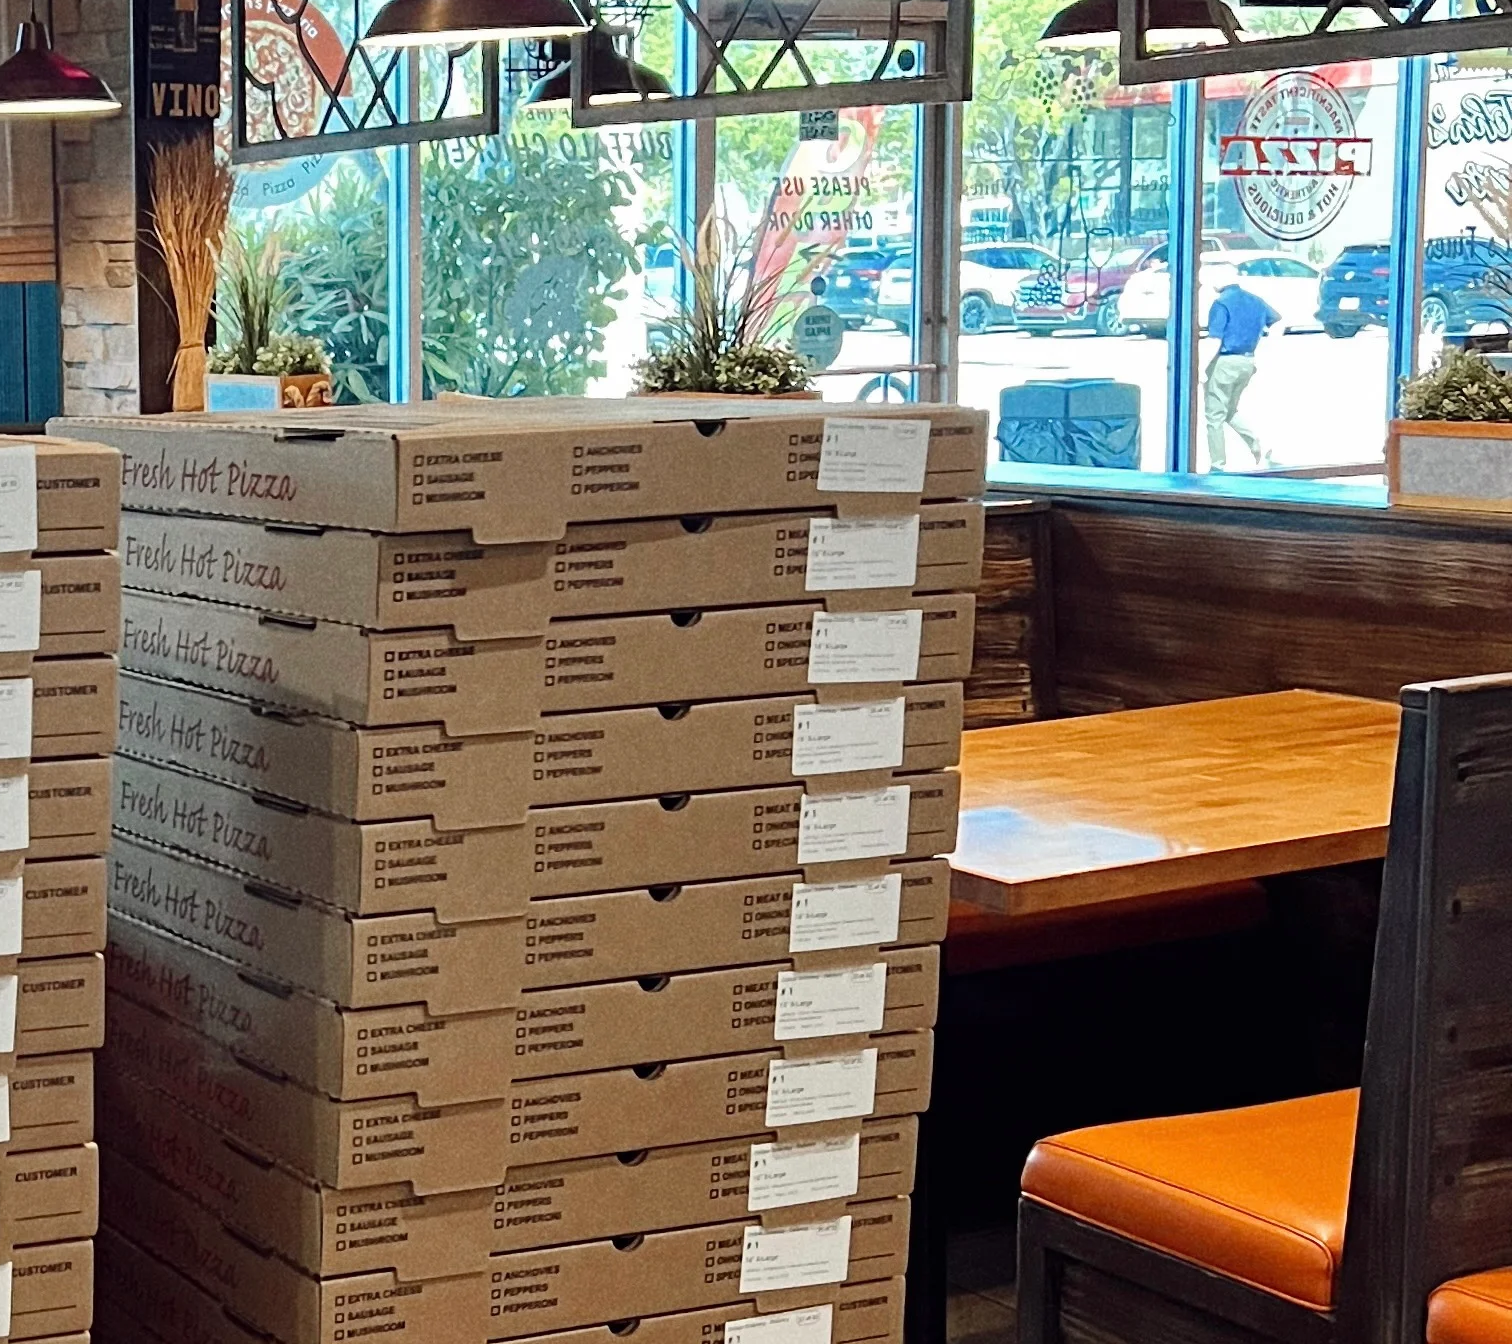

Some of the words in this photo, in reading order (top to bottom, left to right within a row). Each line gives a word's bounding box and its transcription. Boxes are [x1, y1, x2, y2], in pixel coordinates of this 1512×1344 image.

[152, 82, 219, 117] VINO
[37, 478, 101, 491] CUSTOMER
[122, 448, 175, 490] Fresh
[181, 456, 222, 494] Hot
[228, 460, 297, 501] Pizza
[126, 533, 176, 573] Fresh
[180, 544, 218, 580] Hot
[222, 548, 287, 592] Pizza
[123, 617, 171, 657] Fresh
[176, 630, 212, 668] Hot
[216, 638, 279, 685] Pizza
[34, 685, 98, 698] CUSTOMER
[119, 701, 166, 741] Fresh
[170, 714, 206, 753] Hot
[210, 725, 271, 773] Pizza
[28, 786, 92, 800] CUSTOMER
[121, 781, 168, 825] Fresh
[172, 798, 208, 837] Hot
[212, 812, 273, 862] Pizza
[25, 886, 88, 899] CUSTOMER
[114, 862, 161, 907] Fresh
[165, 884, 202, 923] Hot
[204, 897, 265, 951] Pizza
[22, 978, 85, 993] CUSTOMER
[109, 941, 155, 986] Fresh
[160, 966, 196, 1006] Hot
[199, 983, 253, 1033] Pizza
[15, 1166, 78, 1183] CUSTOMER
[12, 1262, 73, 1278] CUSTOMER
